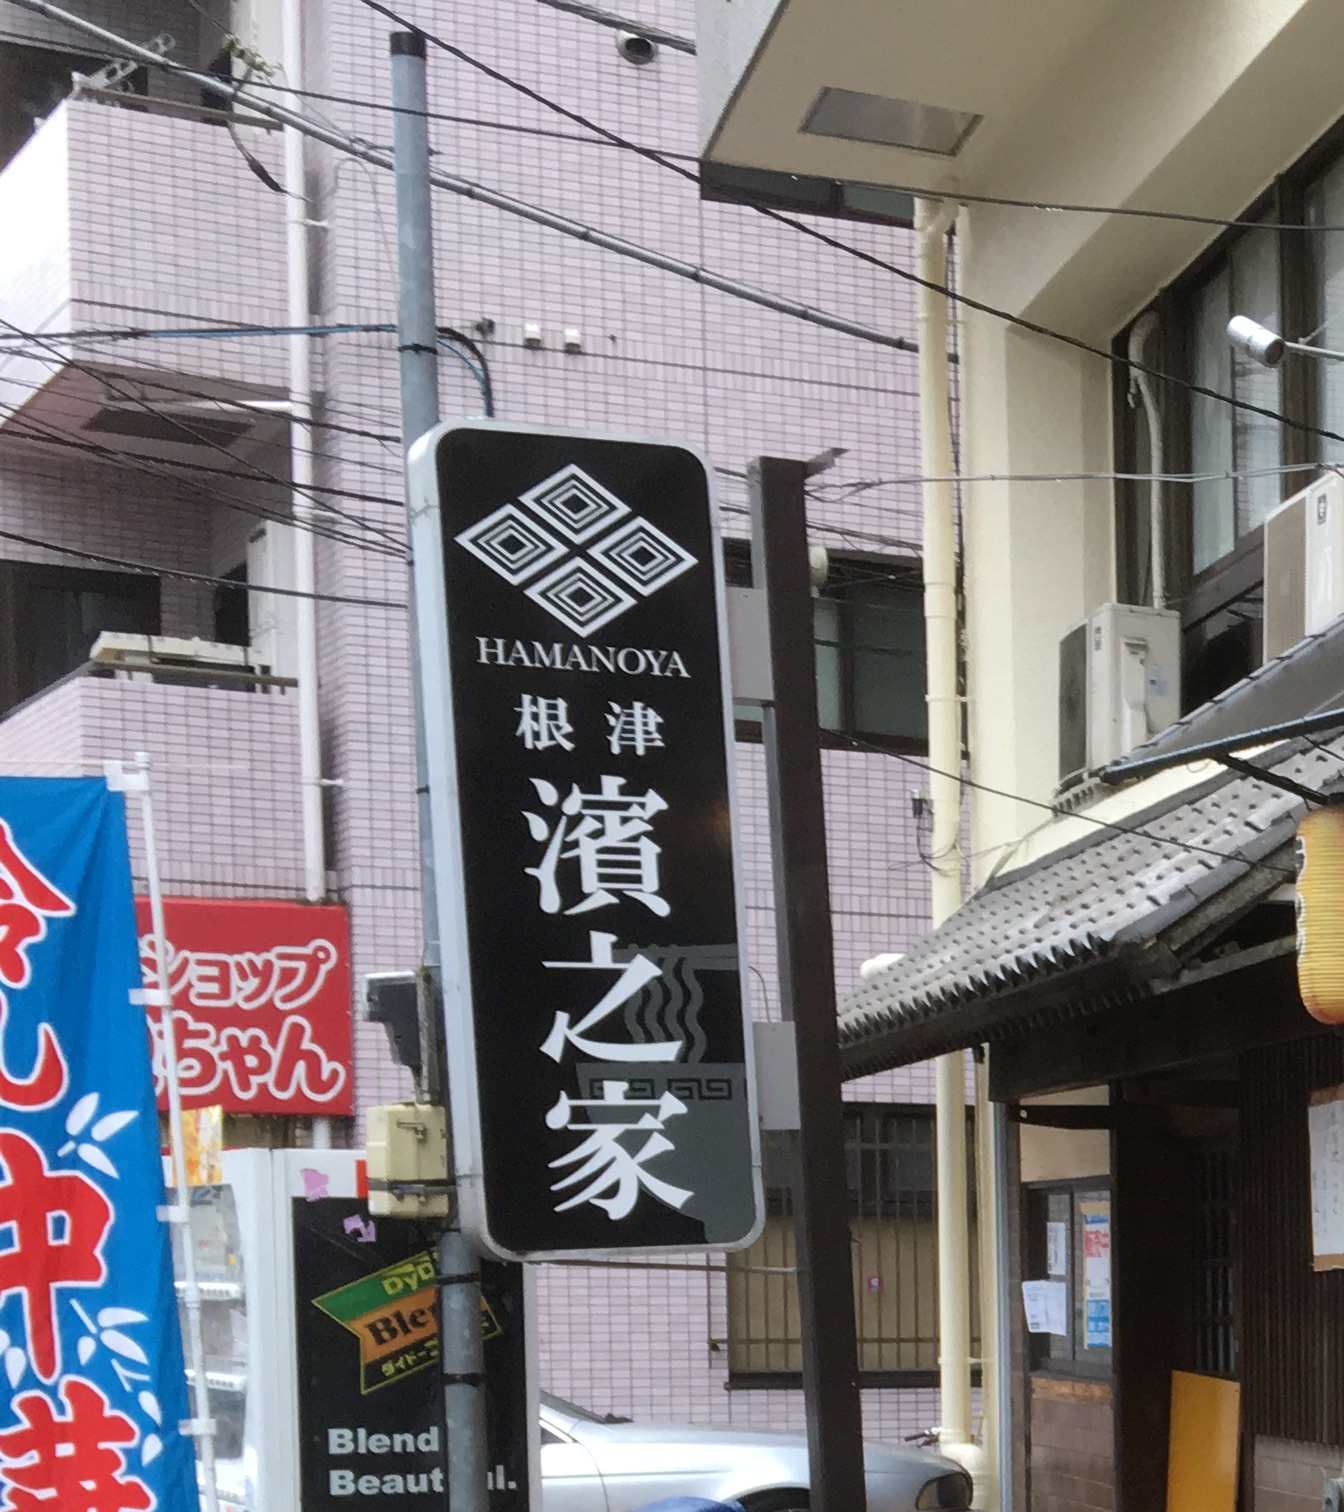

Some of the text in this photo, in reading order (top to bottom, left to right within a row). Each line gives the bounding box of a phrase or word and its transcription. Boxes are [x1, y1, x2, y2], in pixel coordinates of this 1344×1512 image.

[476, 636, 692, 679] HAMANOYA
[514, 692, 666, 756] 根津
[520, 776, 696, 1222] 濱之家
[381, 1261, 436, 1296] DyD
[327, 1426, 440, 1455] Blend
